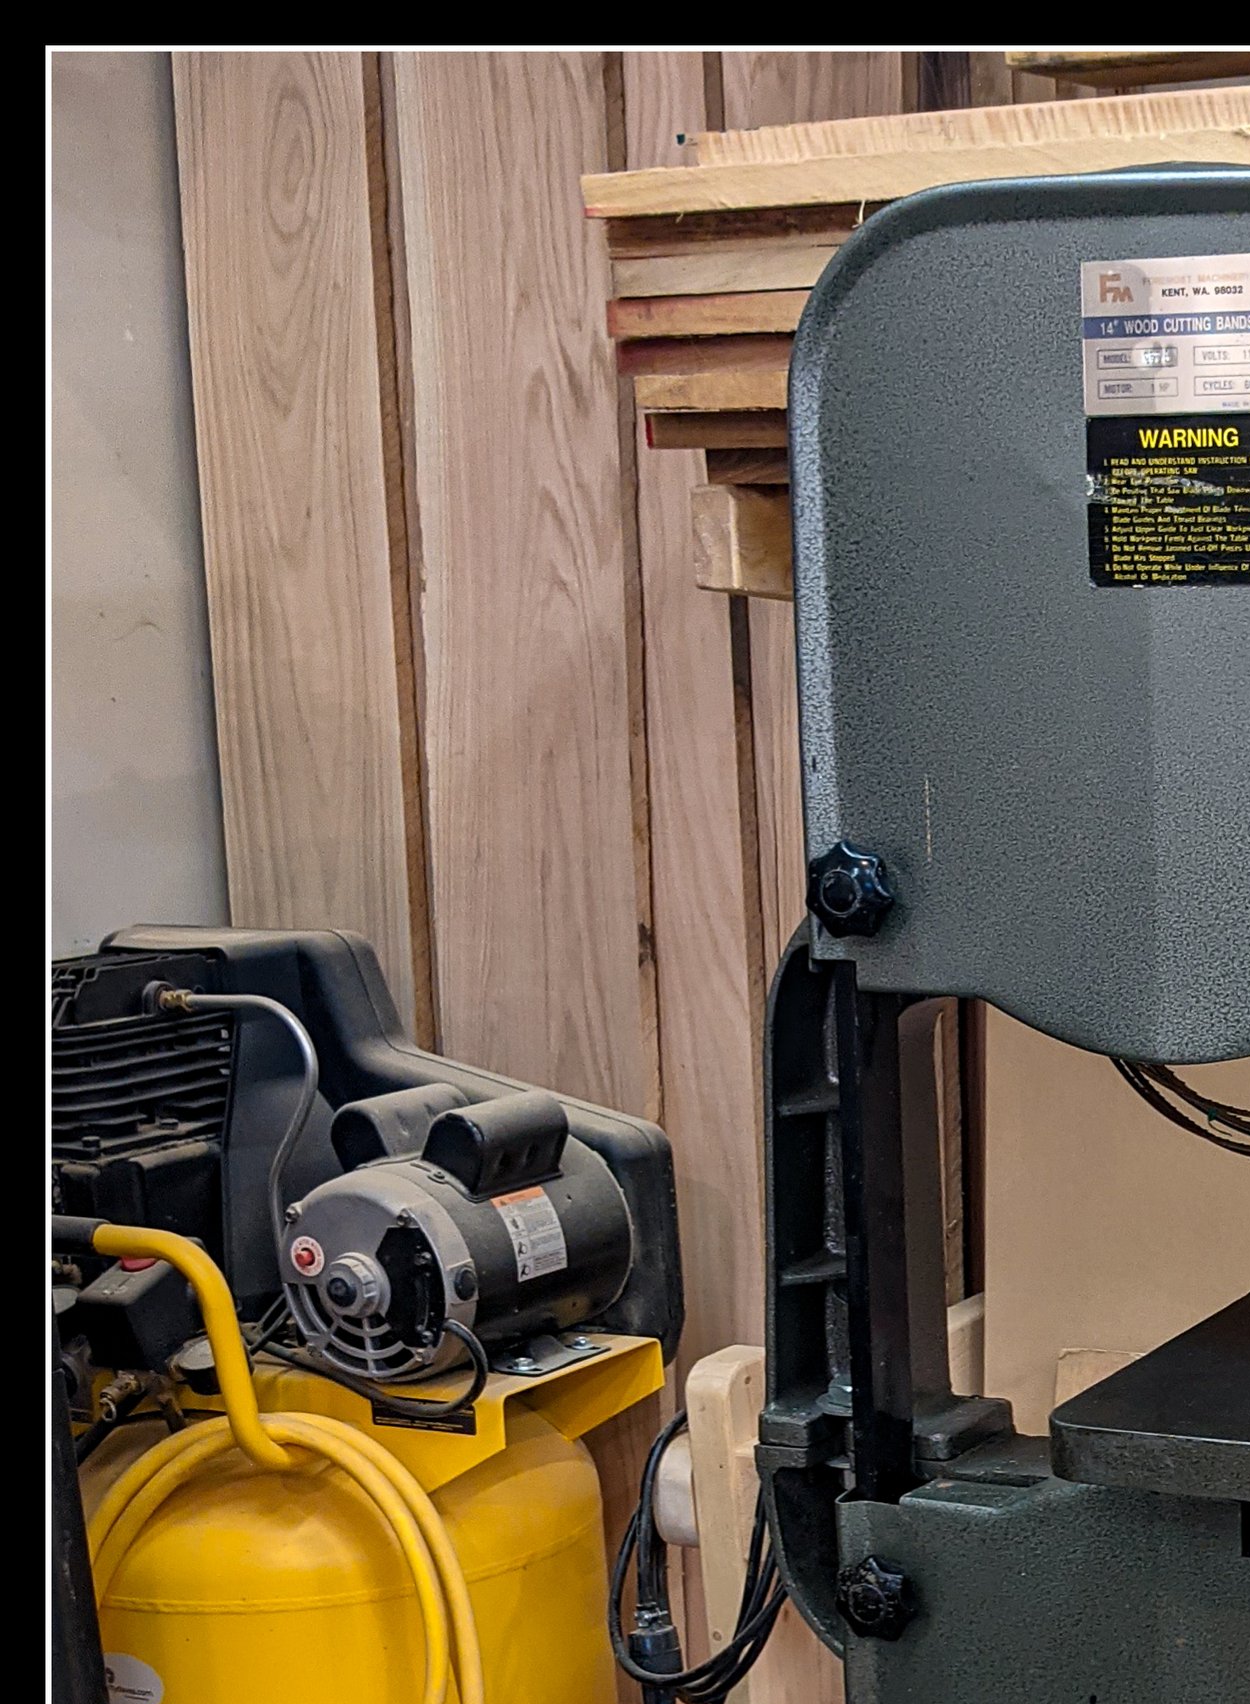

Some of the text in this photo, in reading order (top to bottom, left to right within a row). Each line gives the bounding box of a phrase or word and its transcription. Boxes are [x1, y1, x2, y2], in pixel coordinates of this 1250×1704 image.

[1162, 285, 1243, 298] KENT, WA. 98032
[1125, 318, 1158, 334] WOOD
[1164, 317, 1211, 333] CUTTING
[1202, 350, 1231, 361] VOLTS:
[1139, 428, 1240, 448] WARNING
[1110, 458, 1129, 466] READ
[1131, 457, 1147, 466] AND
[1148, 457, 1196, 466] UNDERSTAND
[1198, 456, 1247, 465] INSTRUCTION
